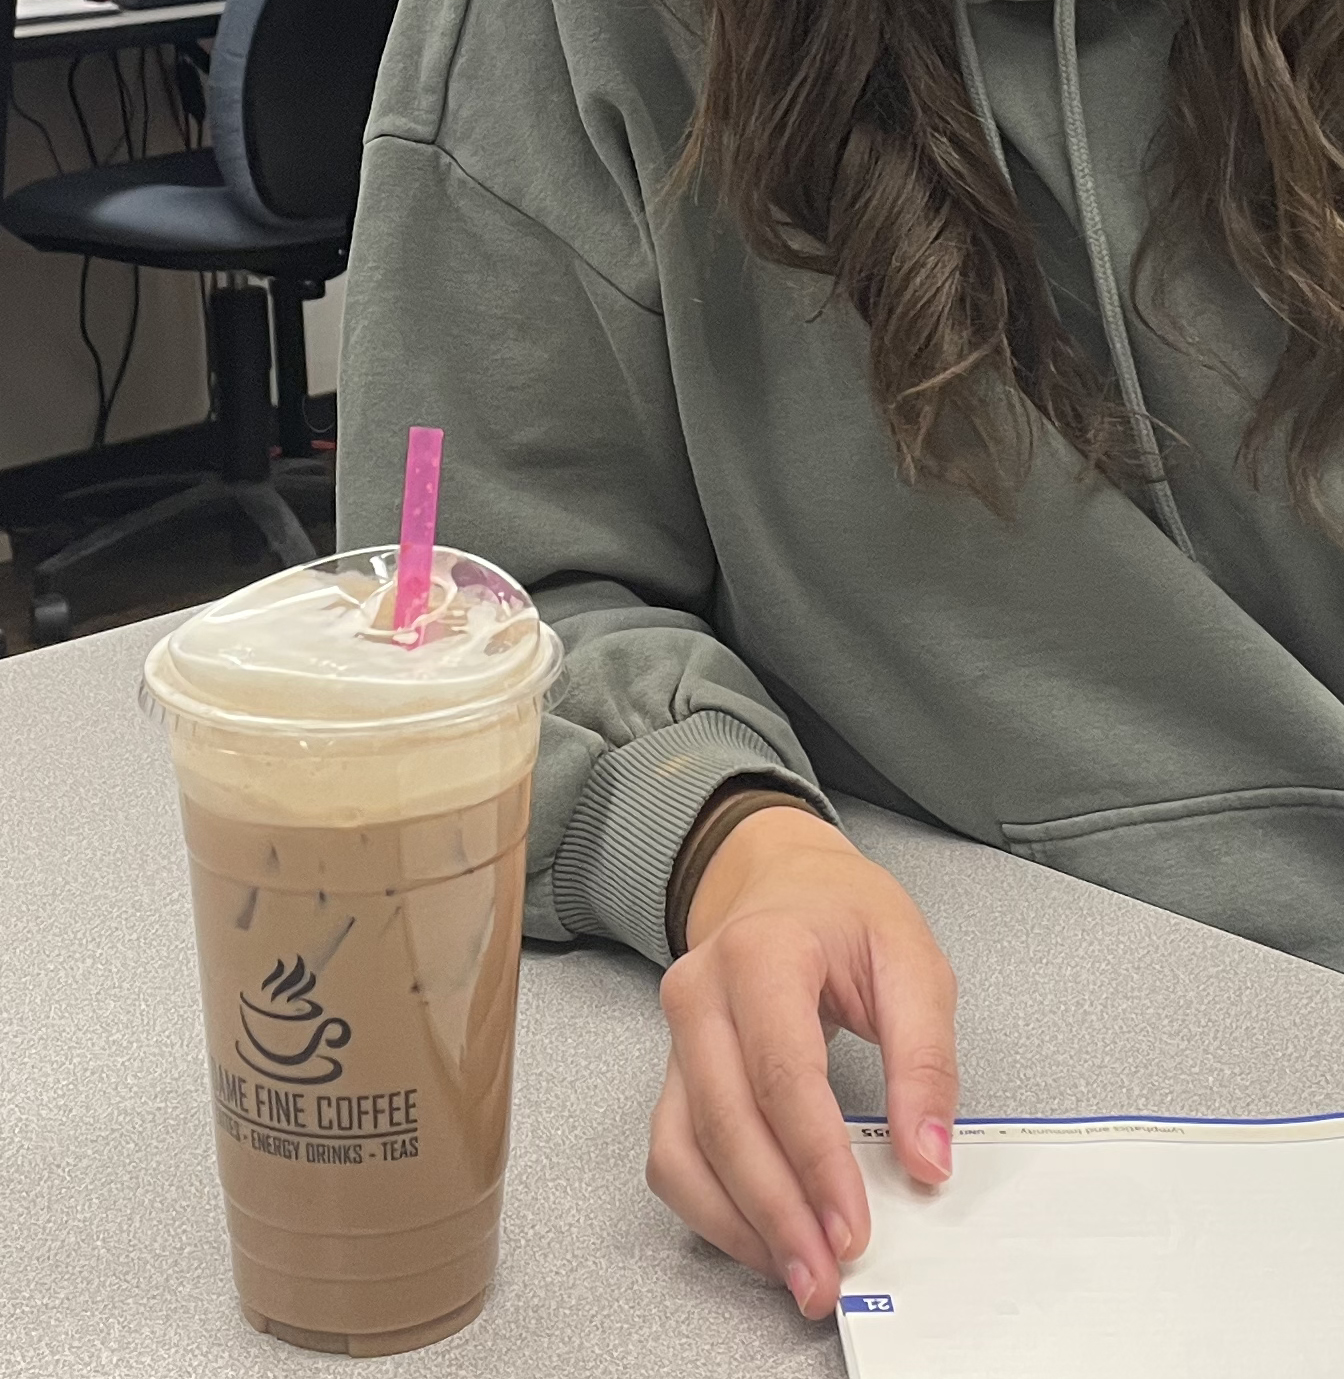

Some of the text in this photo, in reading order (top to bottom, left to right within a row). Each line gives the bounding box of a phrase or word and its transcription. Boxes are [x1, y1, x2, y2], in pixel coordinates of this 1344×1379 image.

[255, 1083, 308, 1130] FINE
[316, 1088, 419, 1131] COFFEE
[1085, 1126, 1110, 1135] and
[250, 1128, 300, 1161] ENERGY
[306, 1142, 363, 1164] DRINKS
[381, 1136, 419, 1162] TEAS
[863, 1298, 890, 1311] 21
